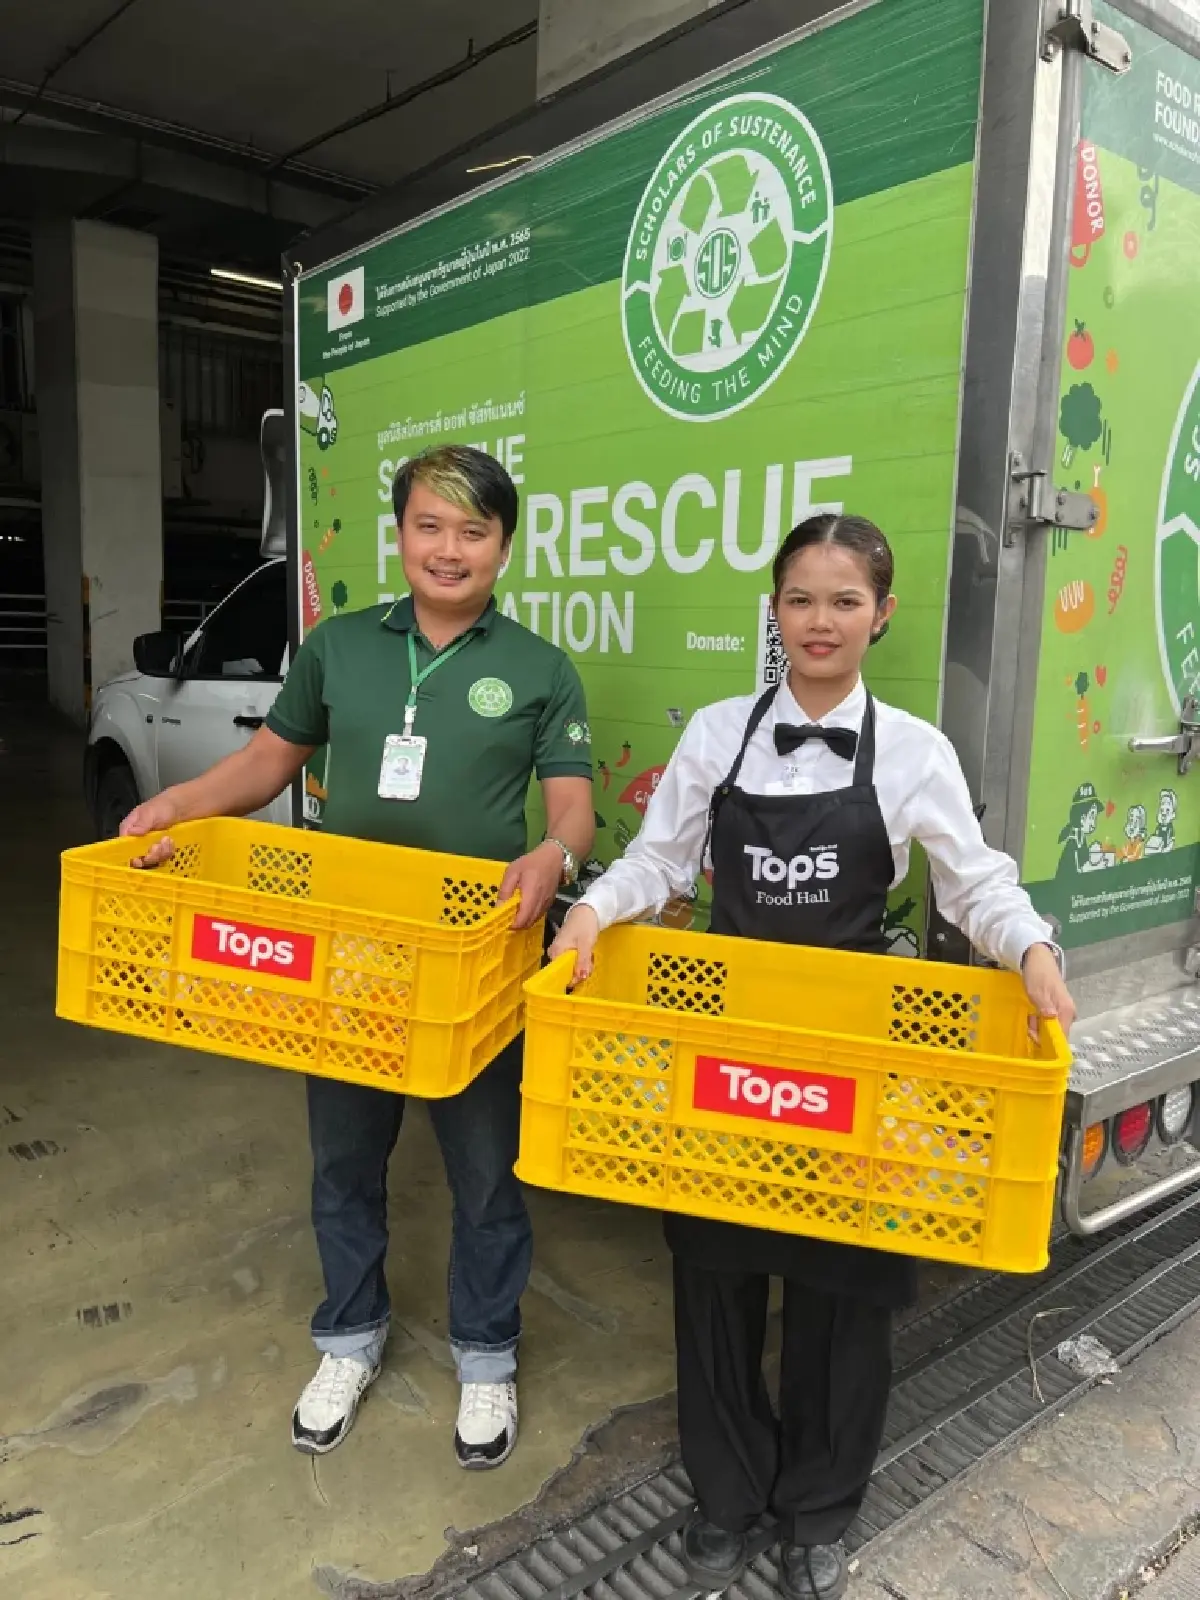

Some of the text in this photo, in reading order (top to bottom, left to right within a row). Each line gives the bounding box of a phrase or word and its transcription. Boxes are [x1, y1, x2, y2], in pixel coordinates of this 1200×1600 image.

[1156, 70, 1192, 108] FOOD
[1155, 101, 1200, 144] FOUND
[636, 115, 816, 260] SCHOLARS OF SUSTENANCE
[1080, 146, 1104, 233] DONOR
[483, 258, 507, 277] Japan
[509, 247, 531, 266] 2022
[638, 294, 803, 404] FEEDING THE MIND
[525, 455, 853, 578] RESCUE
[686, 631, 745, 652] Donate:
[744, 845, 840, 889] Tops
[756, 889, 830, 905] Food Hall
[211, 922, 294, 967] Tops
[719, 1064, 828, 1117] Tops
